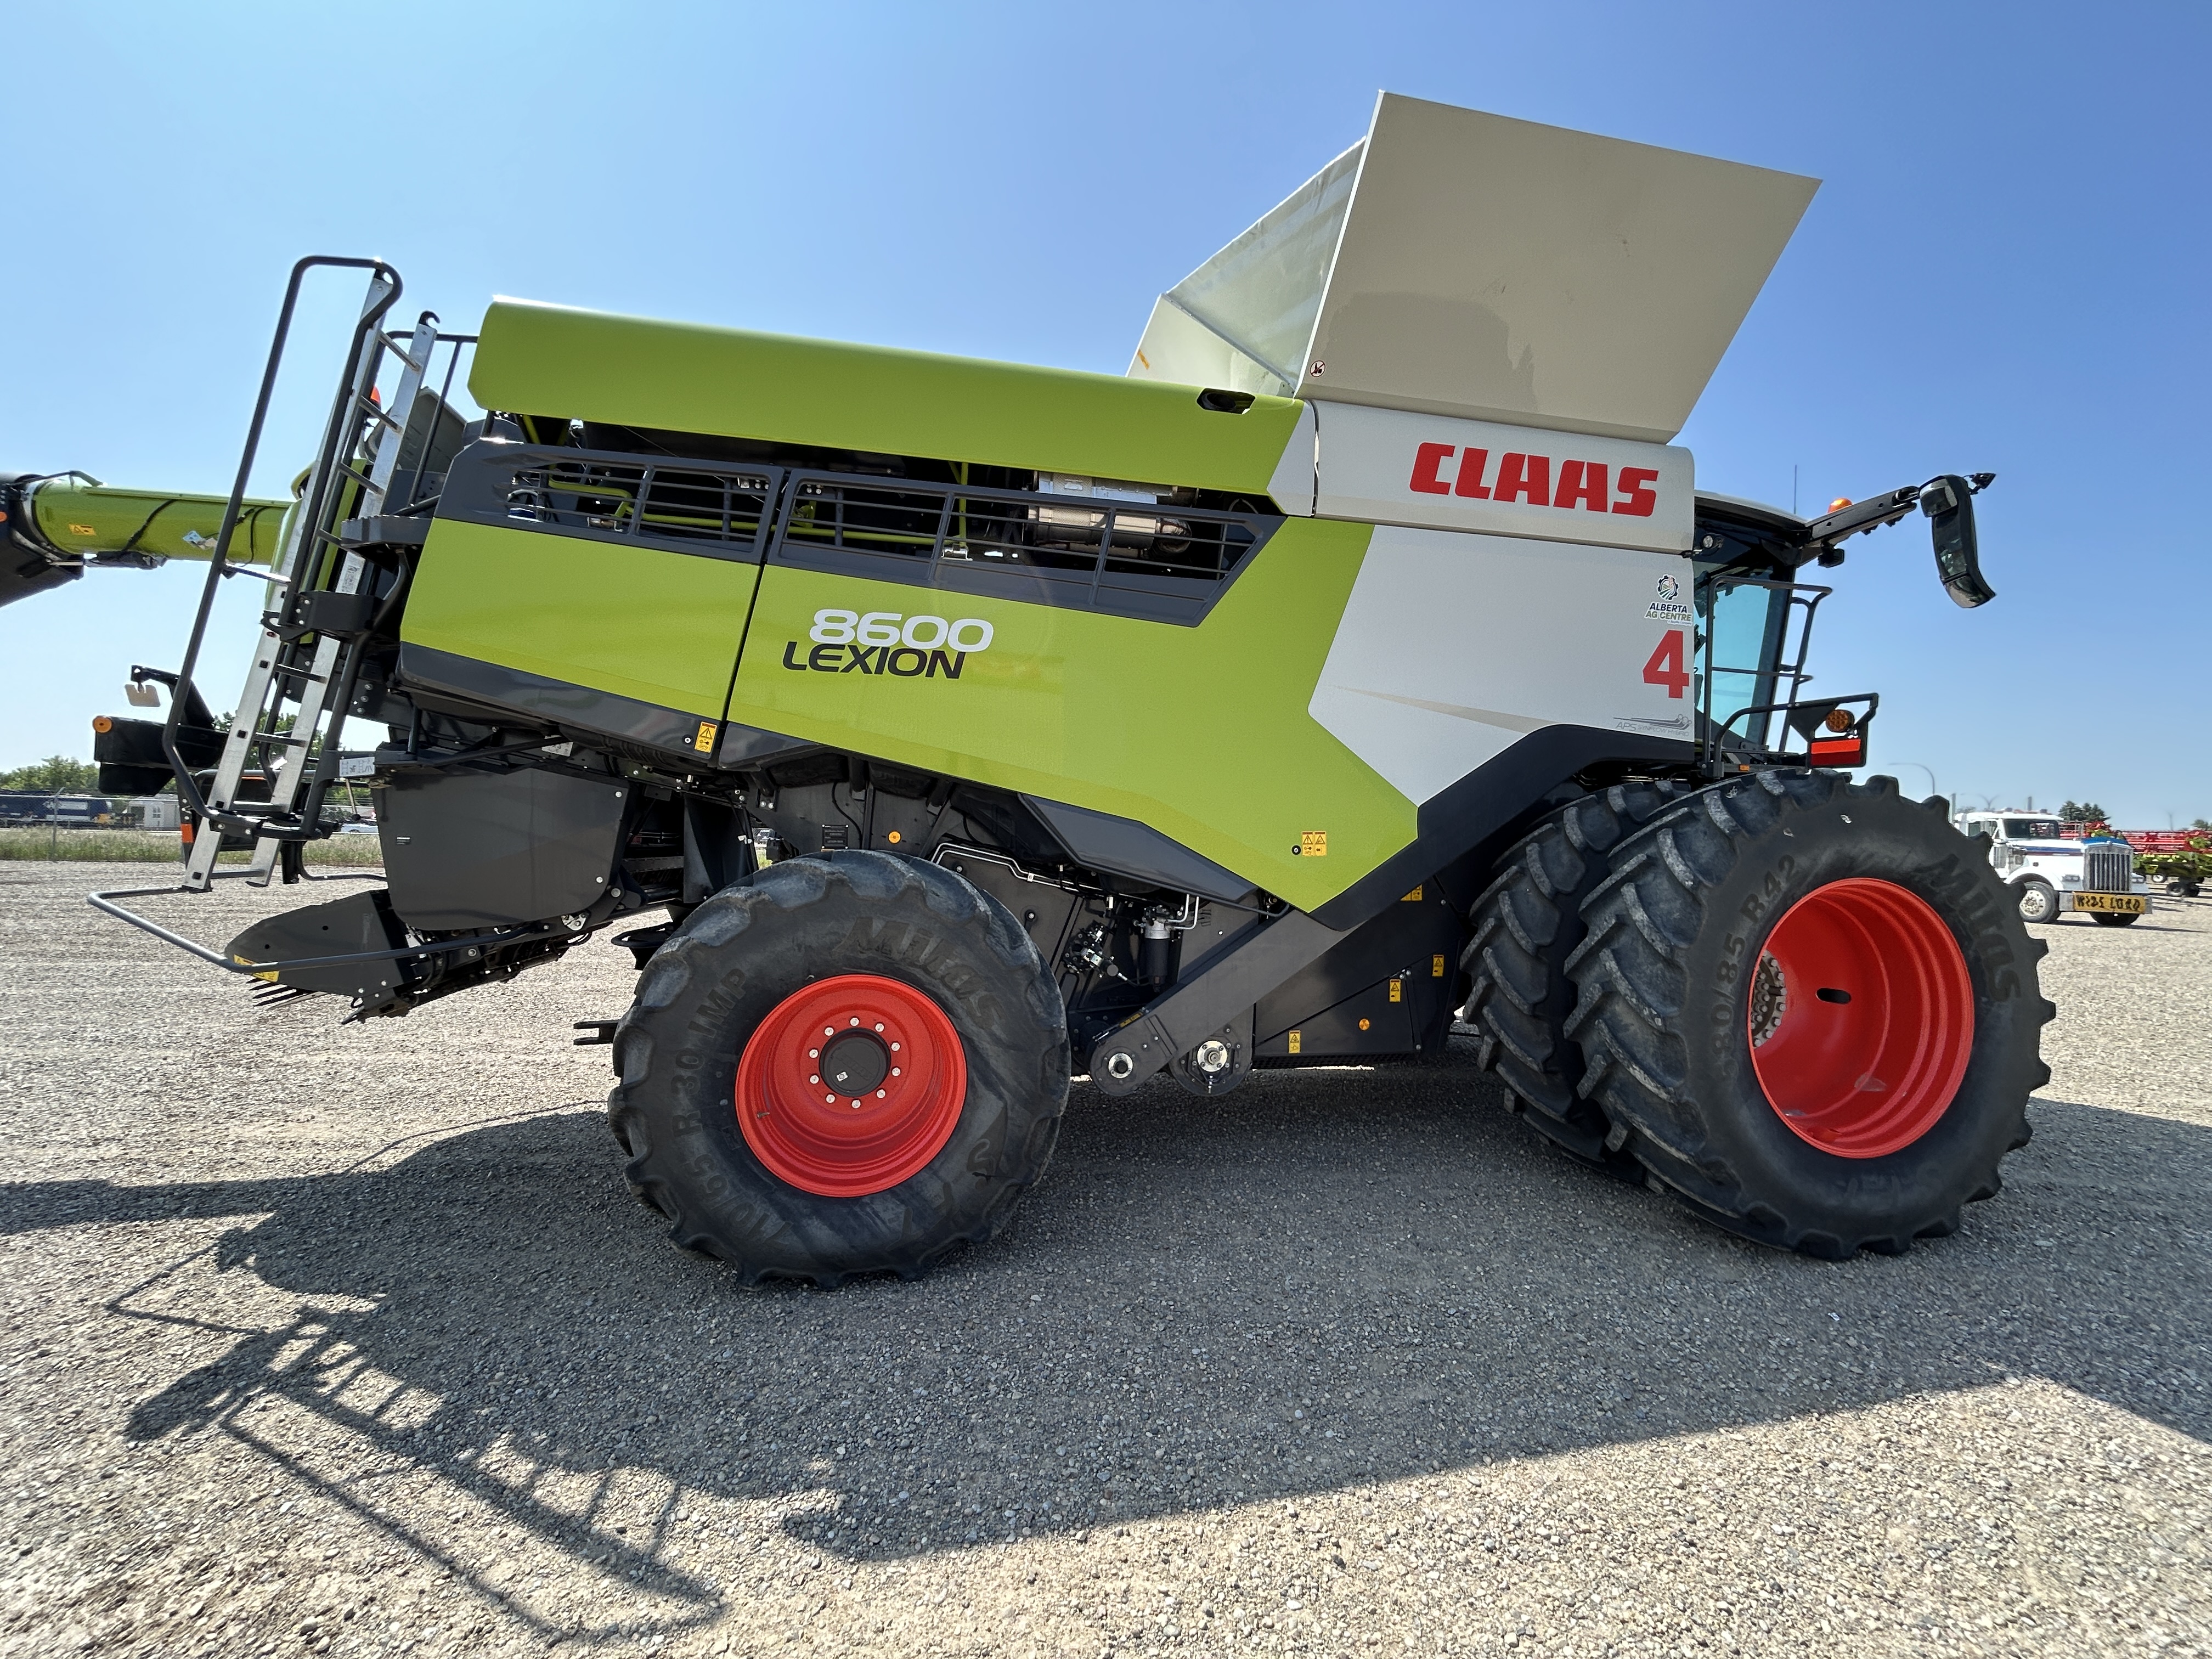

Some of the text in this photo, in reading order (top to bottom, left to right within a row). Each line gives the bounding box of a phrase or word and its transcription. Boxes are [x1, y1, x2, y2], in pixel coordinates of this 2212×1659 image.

[1409, 442, 1659, 517] CLAAS
[1645, 611, 1692, 622] AG CENTRE
[1649, 602, 1688, 613] ALBERTA
[809, 609, 994, 652] 8600
[782, 641, 967, 679] LEXION
[1642, 629, 1690, 699] 4
[1615, 721, 1638, 731] APS
[687, 968, 747, 1039] IMP
